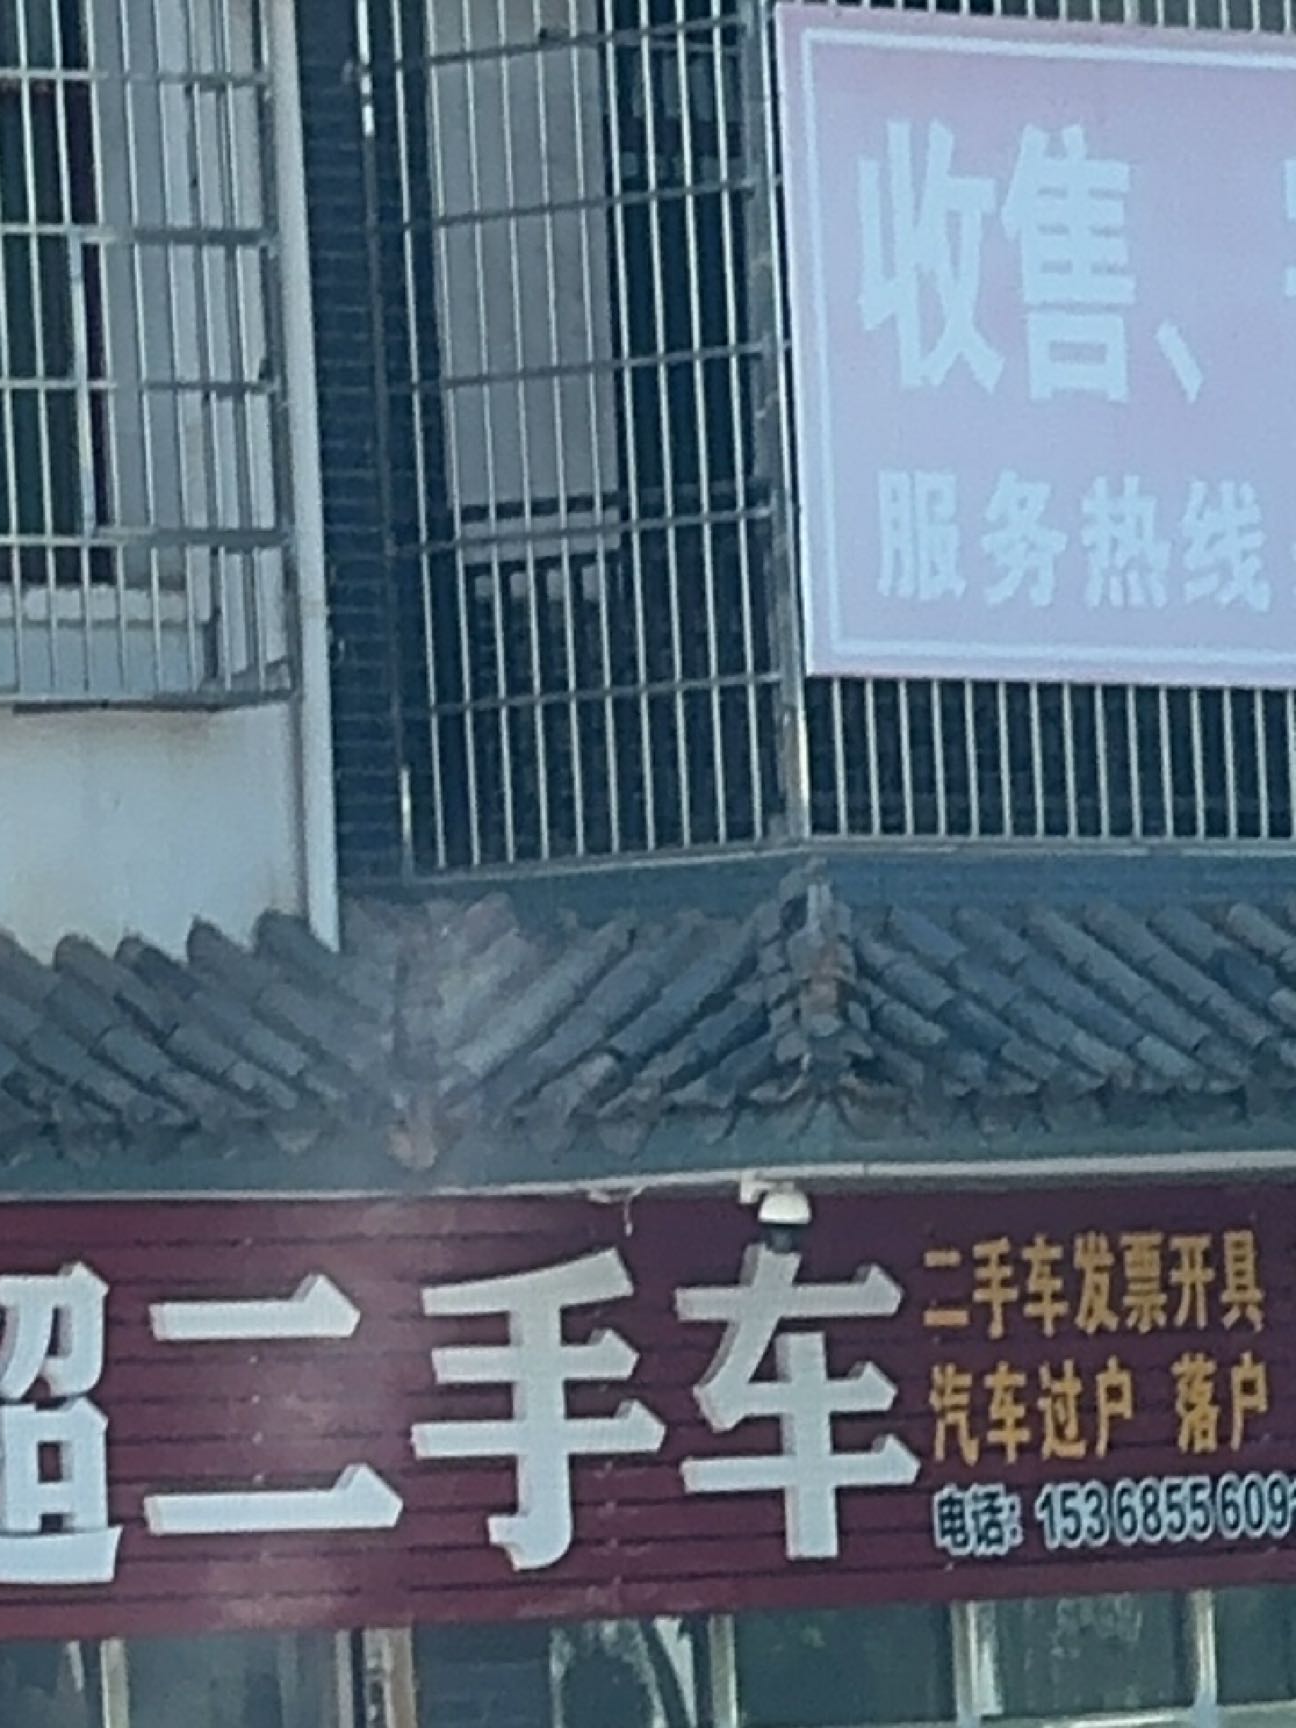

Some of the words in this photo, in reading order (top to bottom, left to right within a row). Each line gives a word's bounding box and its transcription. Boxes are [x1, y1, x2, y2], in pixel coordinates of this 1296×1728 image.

[857, 118, 1296, 403] 收售、
[877, 468, 1272, 613] 服务热线
[922, 1229, 1266, 1340] 二手车发票开具
[928, 1353, 1134, 1467] 汽车过户
[1170, 1350, 1269, 1454] 落户
[1036, 1471, 1296, 1550] 1536855609
